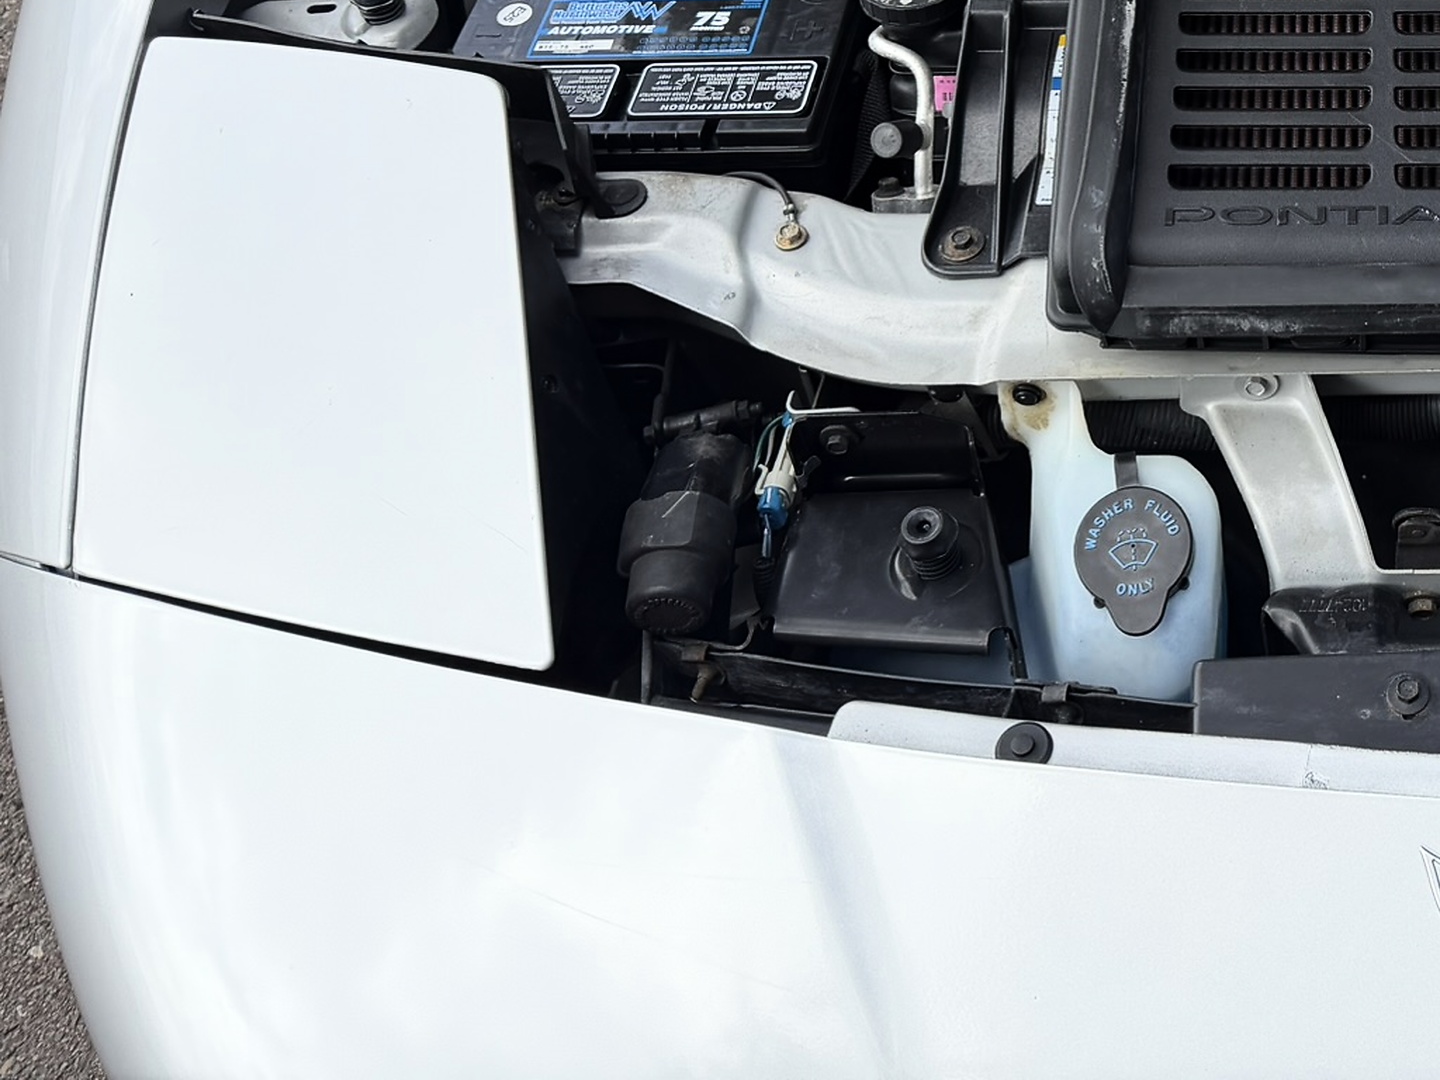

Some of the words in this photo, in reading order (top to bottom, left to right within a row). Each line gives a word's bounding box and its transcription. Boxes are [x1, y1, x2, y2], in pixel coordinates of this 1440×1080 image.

[693, 11, 732, 26] 75
[547, 24, 656, 36] AUTOMOTIVE
[1084, 498, 1134, 551] WASHER
[1144, 500, 1181, 537] FLUID
[1116, 578, 1155, 597] ONLY
